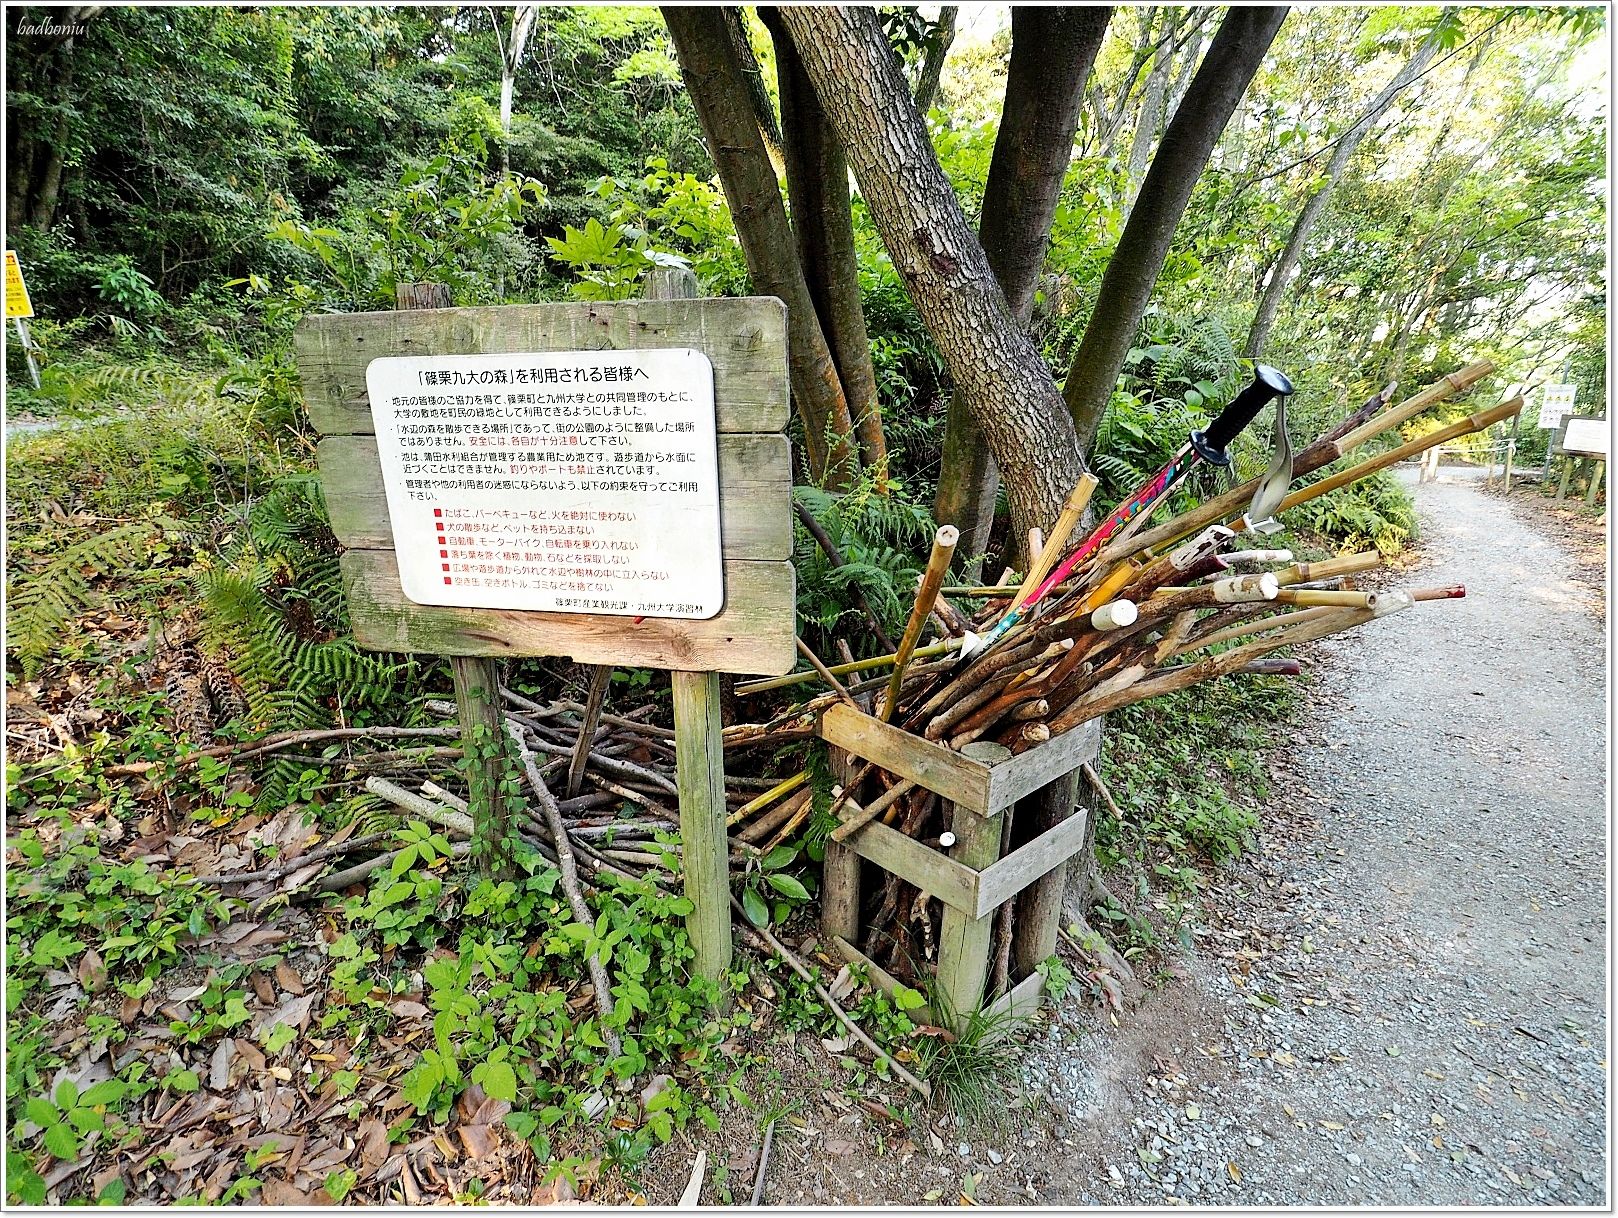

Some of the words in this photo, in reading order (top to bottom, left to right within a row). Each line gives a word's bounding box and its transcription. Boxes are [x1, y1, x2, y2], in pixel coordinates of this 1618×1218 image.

[418, 366, 649, 386] 「篠栗九大の森」を利用される皆様へ
